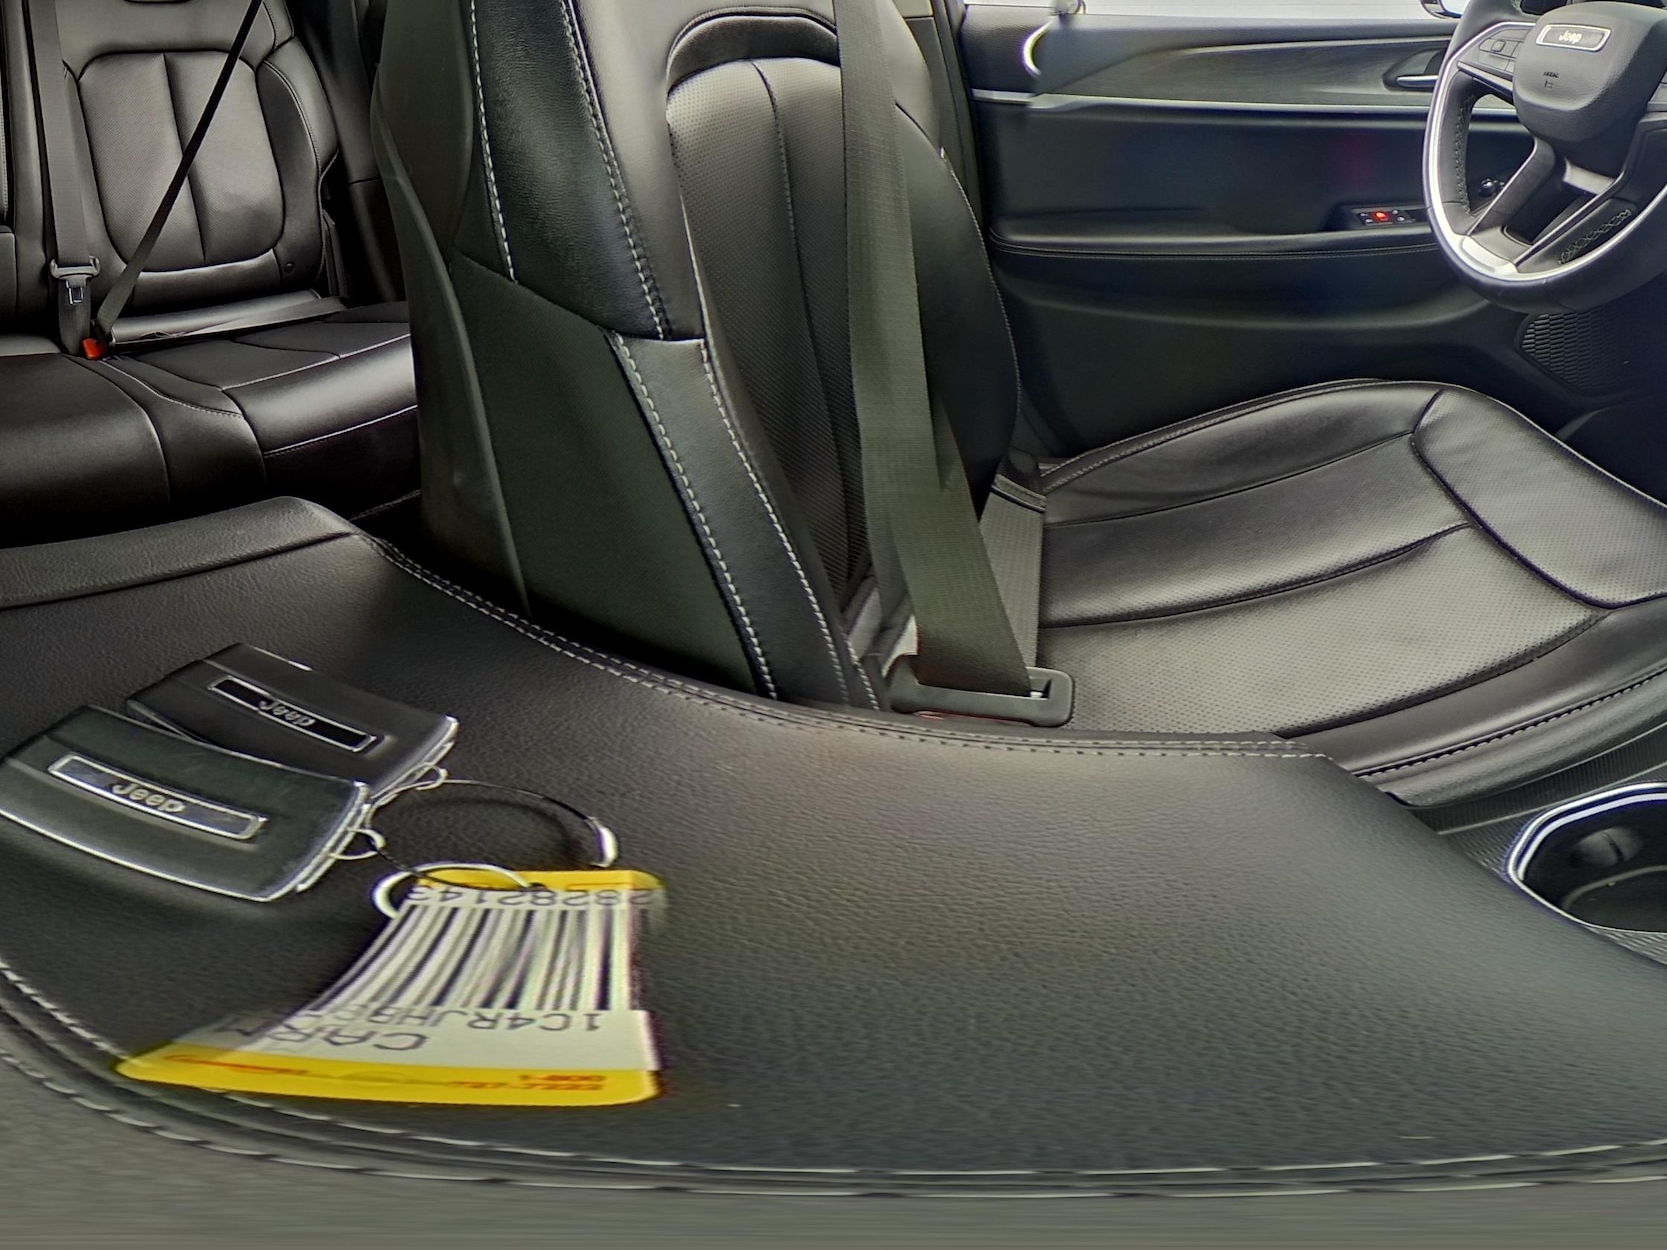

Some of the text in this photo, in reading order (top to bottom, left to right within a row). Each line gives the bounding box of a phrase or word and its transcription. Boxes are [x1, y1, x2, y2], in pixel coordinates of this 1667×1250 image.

[1558, 30, 1582, 44] Jeep
[257, 698, 316, 728] Jeep
[112, 781, 187, 814] Jeep
